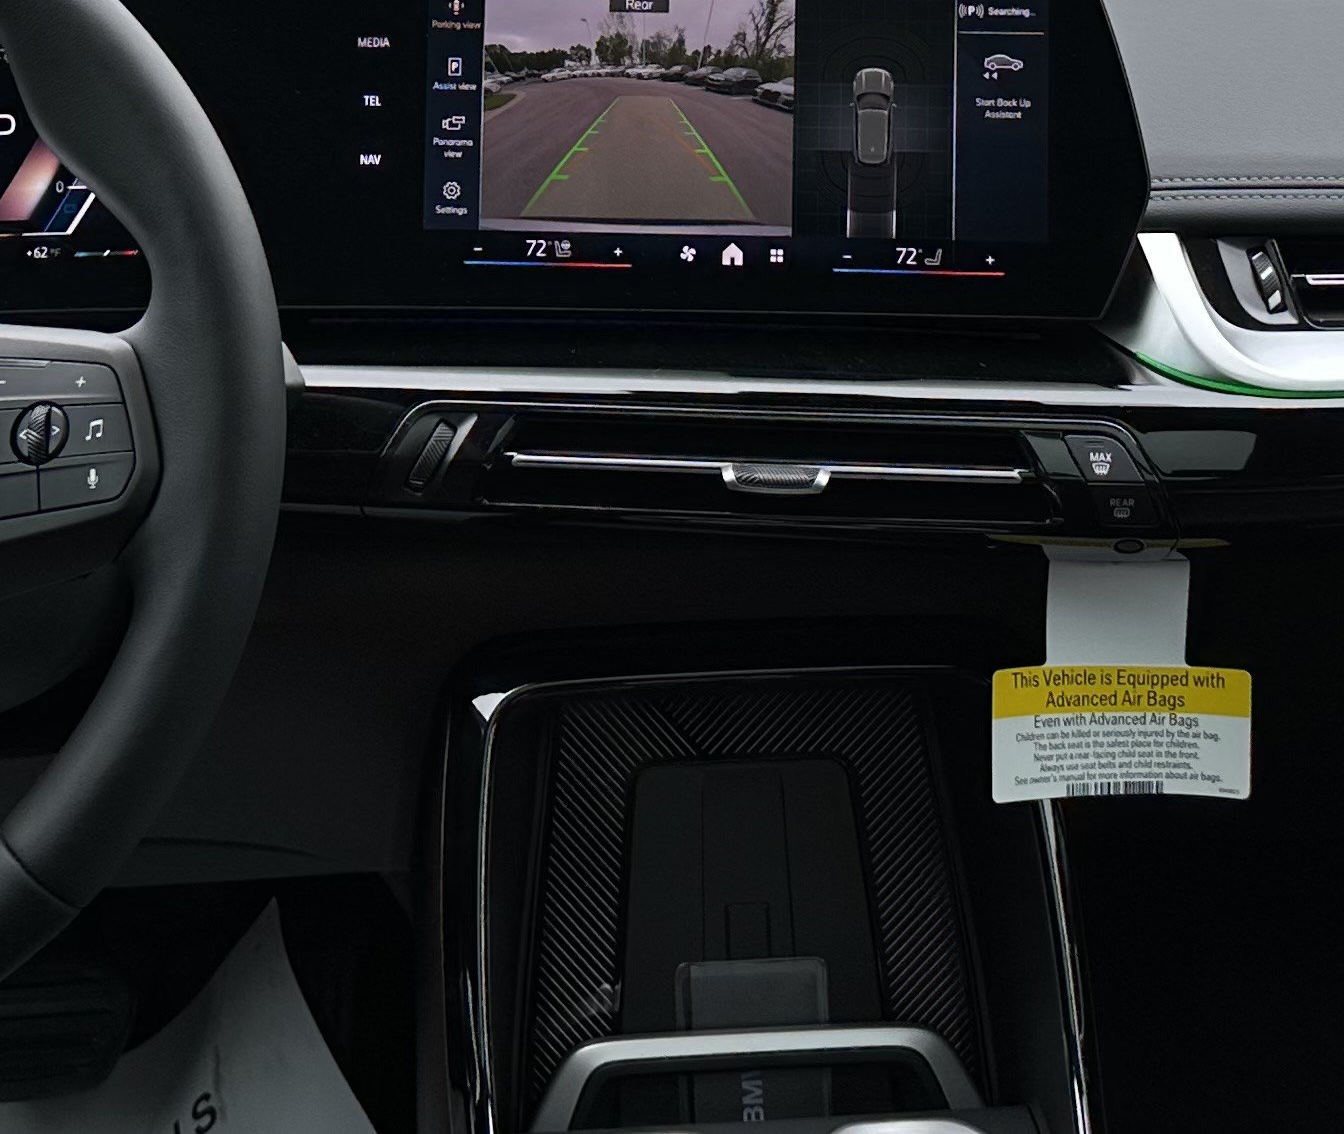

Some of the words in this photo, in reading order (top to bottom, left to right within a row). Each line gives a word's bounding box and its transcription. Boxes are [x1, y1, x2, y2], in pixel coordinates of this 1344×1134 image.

[431, 19, 461, 31] Parking
[463, 20, 482, 29] view
[357, 36, 390, 48] MEDIA
[432, 81, 456, 91] Assist
[458, 82, 477, 91] view
[363, 95, 382, 107] TEL
[975, 97, 995, 108] Start
[997, 97, 1017, 108] Back
[1018, 97, 1031, 109] Up
[984, 109, 1022, 119] Assistant
[432, 137, 473, 147] Panorama
[359, 154, 382, 165] NAV
[443, 149, 463, 158] view
[435, 204, 468, 216] Settings
[1089, 452, 1112, 462] MAX
[1109, 498, 1135, 508] REAR
[1011, 671, 1040, 689] This
[1043, 669, 1097, 687] Vehicle
[1100, 669, 1113, 686] is
[1116, 669, 1189, 689] Equipped
[1193, 672, 1226, 689] with
[1045, 690, 1118, 708] Advanced
[1121, 689, 1144, 707] Air
[1147, 690, 1186, 711] Bags
[1034, 714, 1060, 729] Even
[1062, 713, 1087, 727] with
[1089, 712, 1146, 726] Advanced
[1148, 713, 1166, 726] Air
[1169, 713, 1200, 729] Bags
[1015, 732, 1045, 742] Children
[1060, 730, 1069, 739] be
[1071, 730, 1091, 739] killed
[1102, 729, 1136, 740] seriously
[1137, 729, 1164, 740] injured
[1165, 730, 1175, 740] by
[1176, 730, 1190, 739] the
[1191, 730, 1201, 739] air
[1203, 730, 1221, 742] bag.
[1034, 742, 1047, 751] The
[1048, 741, 1066, 750] back
[1067, 741, 1083, 749] seat
[1092, 740, 1105, 748] the
[1106, 740, 1129, 749] safest
[1131, 740, 1152, 750] place
[1153, 740, 1164, 748] for
[1165, 740, 1200, 750] children.
[1033, 752, 1055, 762] Never
[1055, 752, 1068, 762] put
[1117, 750, 1136, 758] child
[1137, 750, 1154, 758] seat
[1155, 750, 1163, 758] in
[1164, 750, 1177, 758] the
[1178, 750, 1200, 759] front.
[1039, 763, 1065, 773] Always
[1080, 762, 1096, 770] seat
[1097, 760, 1116, 769] belts
[1118, 760, 1132, 769] and
[1133, 760, 1153, 769] child
[1014, 776, 1028, 785] See
[1058, 772, 1085, 781] manual
[1086, 772, 1097, 780] for
[1098, 772, 1118, 780] more
[1119, 771, 1163, 780] information
[1164, 771, 1188, 780] about
[1189, 772, 1199, 780] air
[1200, 771, 1223, 783] bags.
